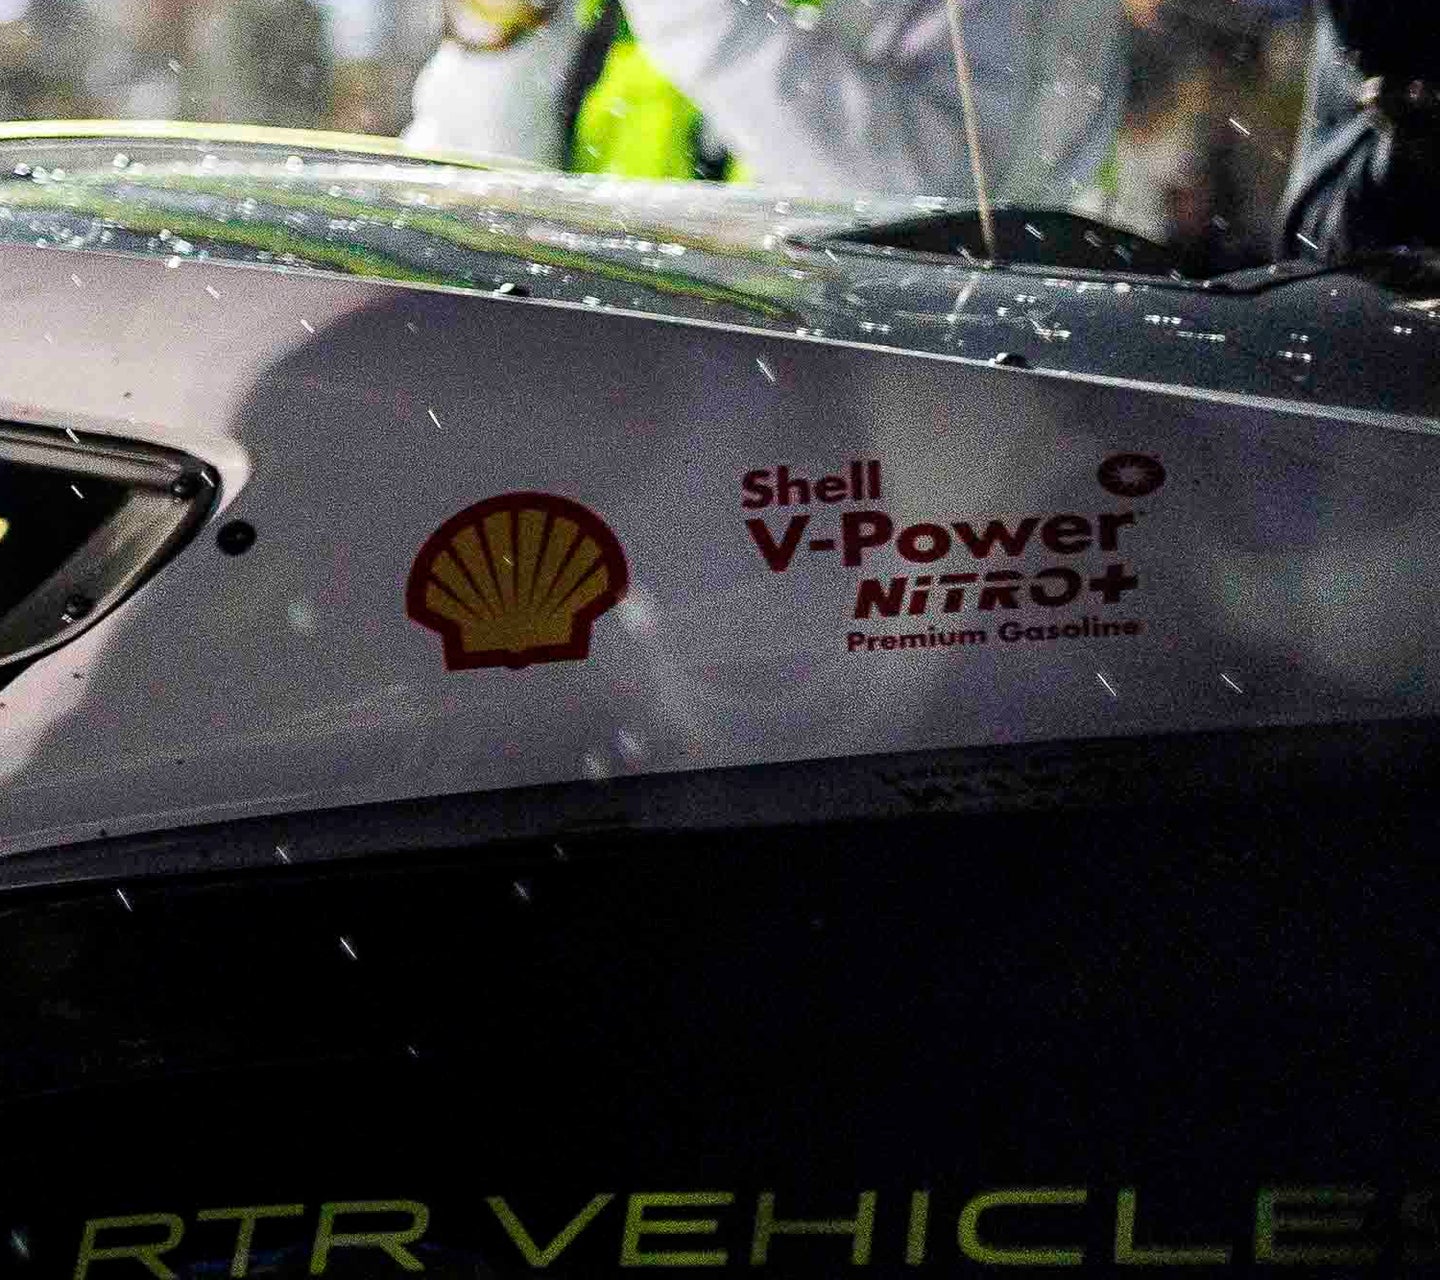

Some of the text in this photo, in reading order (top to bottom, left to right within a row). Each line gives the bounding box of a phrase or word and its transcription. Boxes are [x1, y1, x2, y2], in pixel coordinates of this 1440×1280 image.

[741, 460, 880, 509] Shell
[745, 510, 1135, 574] V-Power
[847, 616, 1142, 652] Premium Gasoline
[73, 1195, 432, 1280] RTR
